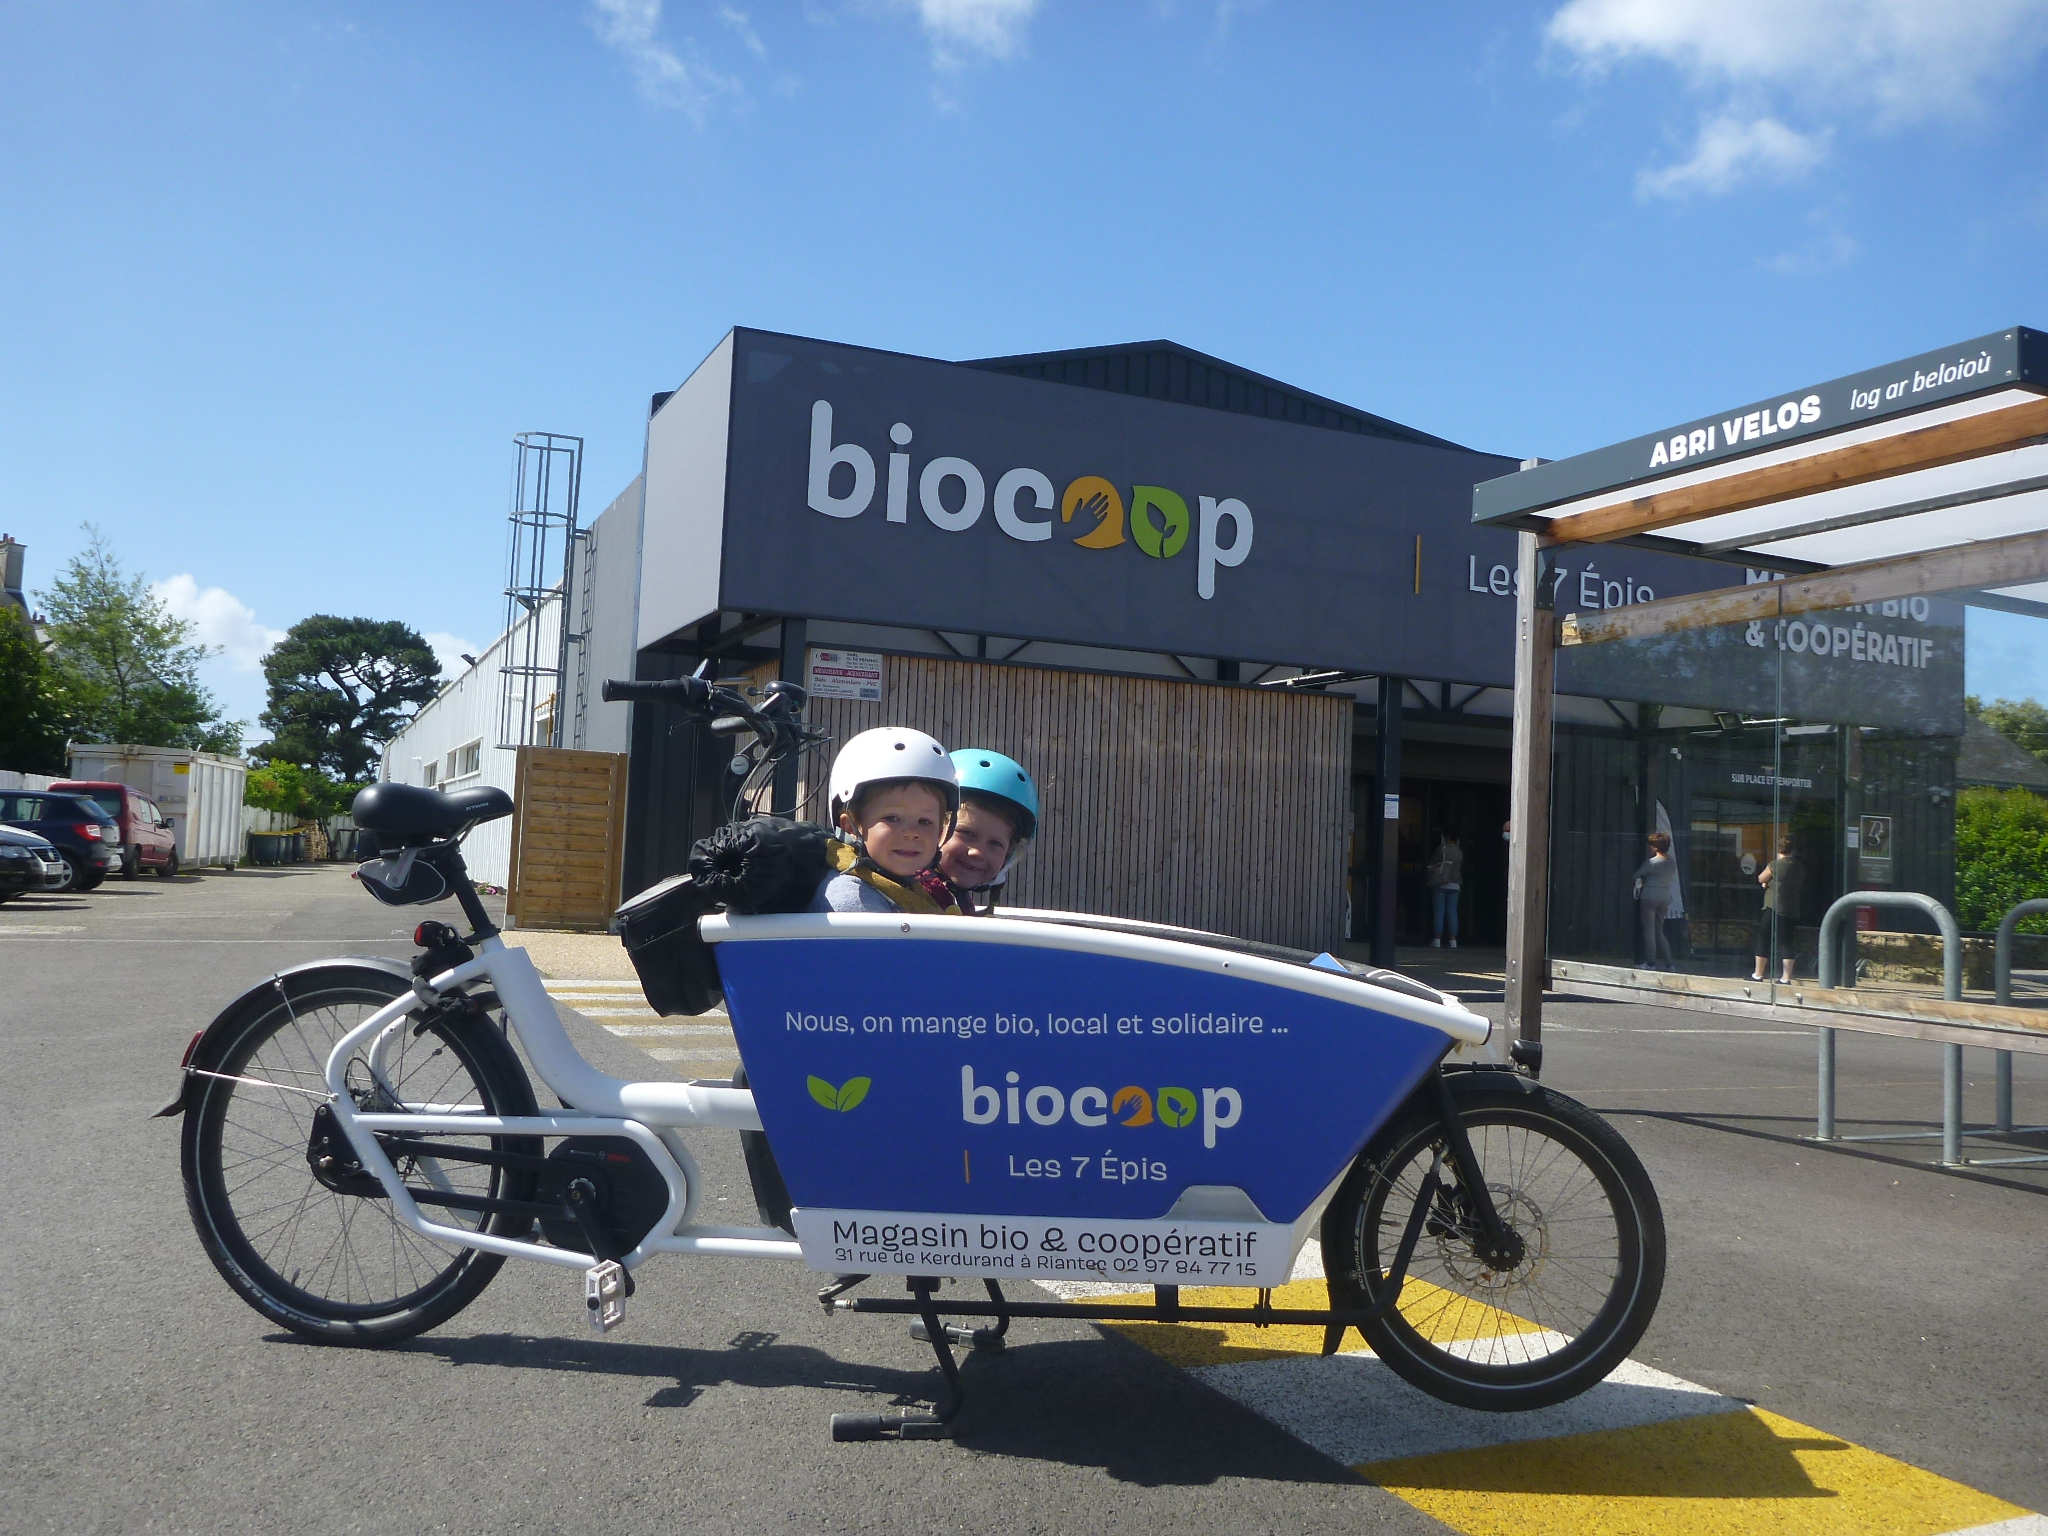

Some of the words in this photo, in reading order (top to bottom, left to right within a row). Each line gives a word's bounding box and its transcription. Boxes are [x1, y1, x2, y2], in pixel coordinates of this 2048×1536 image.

[1849, 389, 1881, 411] log
[1884, 378, 1909, 400] ar
[1911, 350, 1992, 393] beloioù
[1648, 424, 1715, 468] ABRI
[1722, 394, 1822, 446] VELOS
[807, 400, 1254, 600] biocoop
[1745, 620, 1765, 648] &
[1774, 619, 1933, 669] COOPÉRATIF
[1731, 773, 1744, 783] SUR
[1745, 774, 1766, 785] PLACE
[1778, 777, 1812, 788] EMPORTER
[785, 1011, 855, 1035] Nous,
[862, 1016, 893, 1033] on
[901, 1014, 987, 1039] mange
[995, 1013, 1040, 1037] bio,
[1048, 1013, 1108, 1034] local
[1116, 1014, 1144, 1034] et
[1151, 1012, 1263, 1034] solidaire
[960, 1064, 1242, 1149] biocoop
[1008, 1154, 1062, 1179] Les
[1070, 1156, 1090, 1179] 7
[1101, 1148, 1168, 1185] Épis
[833, 1220, 968, 1252] Magasin
[980, 1223, 1029, 1251] bio
[1040, 1227, 1068, 1252] &
[1077, 1228, 1257, 1260] coopératif
[835, 1247, 853, 1262] 31
[859, 1250, 888, 1263] rue
[893, 1250, 915, 1264] de
[921, 1251, 1015, 1268] Kerdurand
[1021, 1253, 1031, 1268] à
[1037, 1255, 1107, 1271] Riantec
[1113, 1258, 1139, 1272] 02
[1145, 1259, 1170, 1273] 97
[1175, 1260, 1202, 1274] 84
[1208, 1261, 1230, 1275] 77
[1236, 1262, 1257, 1276] 15
